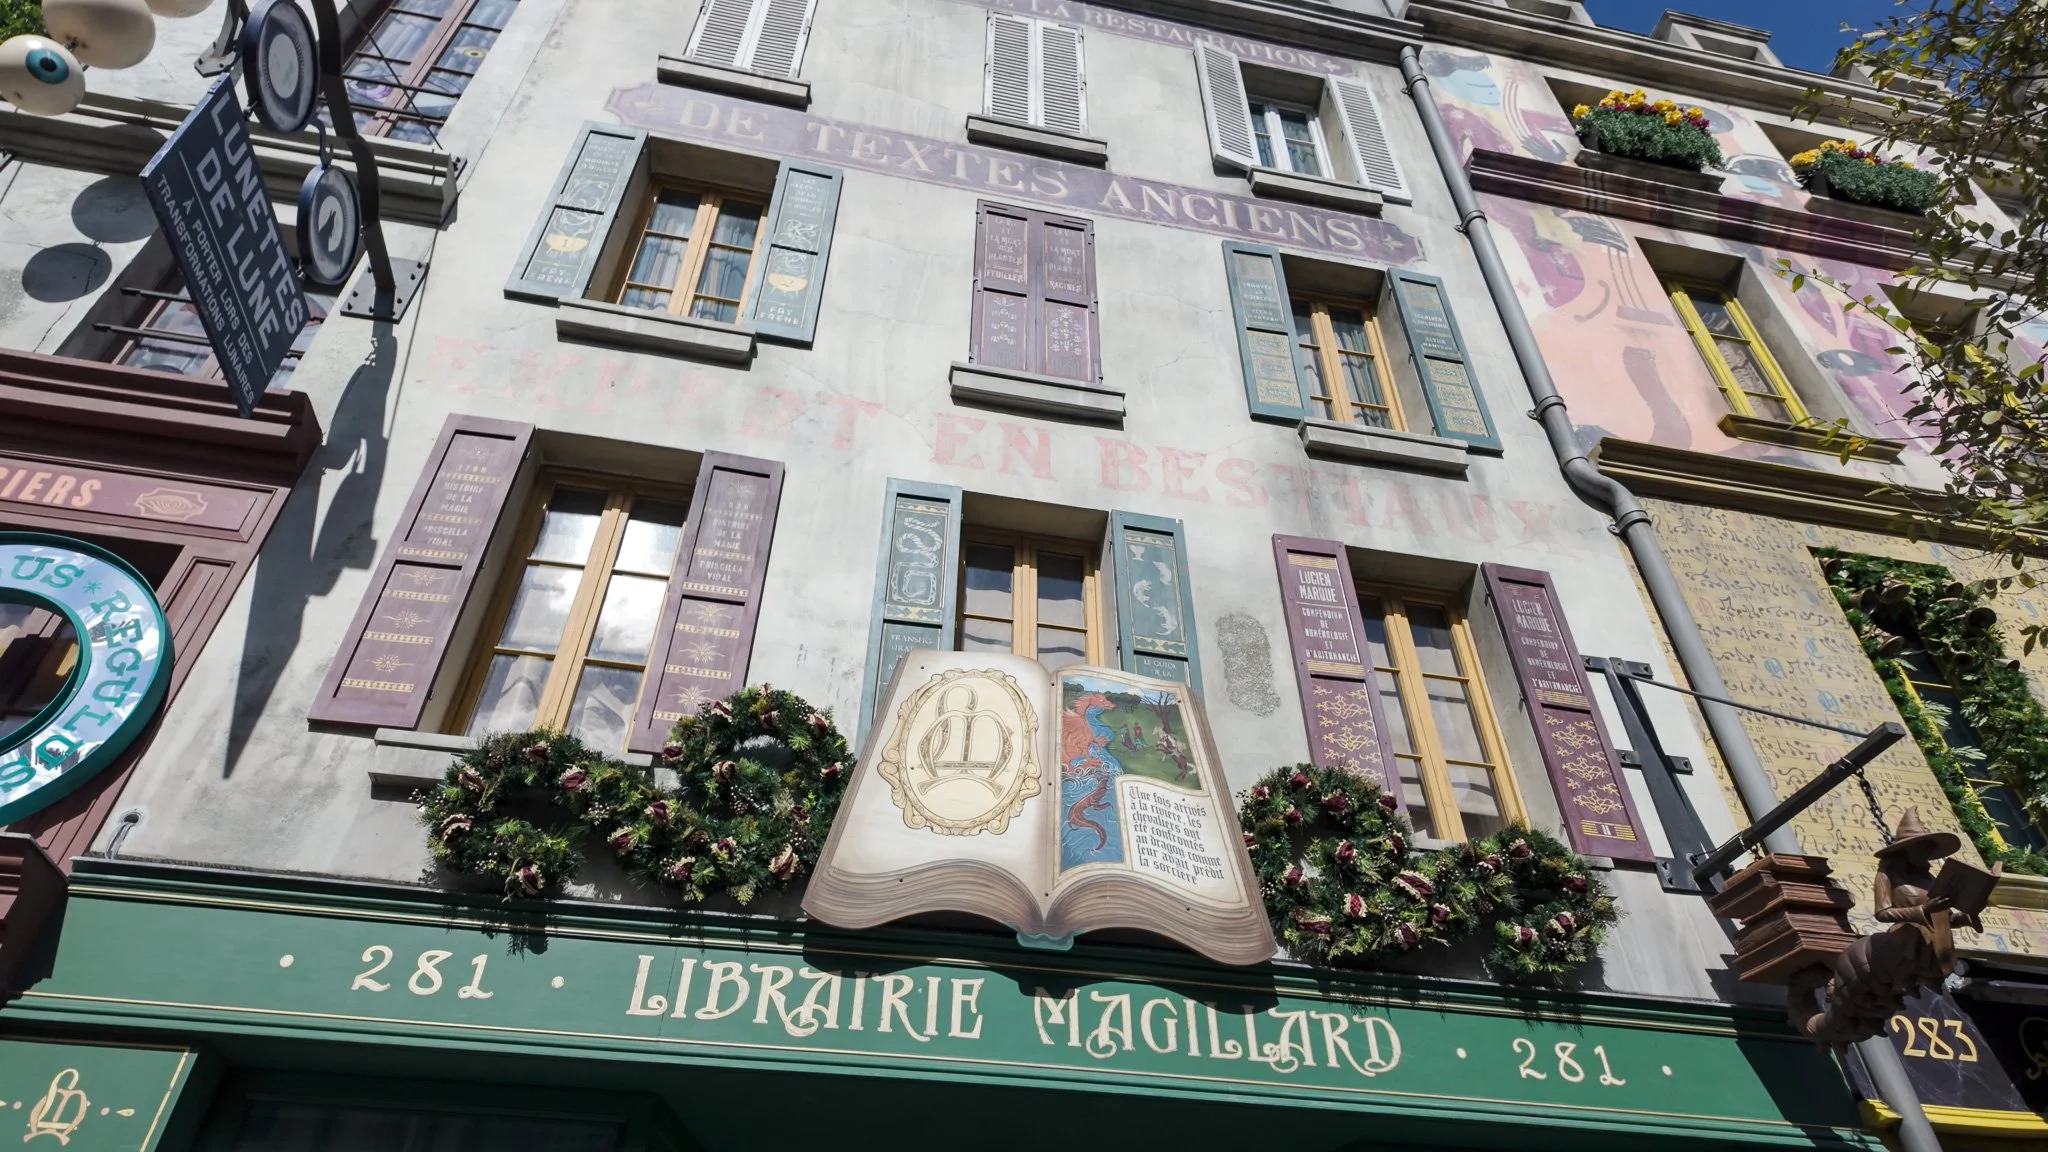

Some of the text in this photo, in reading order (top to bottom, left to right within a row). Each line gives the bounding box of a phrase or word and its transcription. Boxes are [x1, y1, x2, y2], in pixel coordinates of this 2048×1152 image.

[1083, 9, 1321, 69] RESTAURATION
[679, 101, 1367, 254] DE TEXTES ANCIENS
[210, 90, 304, 336] LUNETTES
[196, 148, 281, 352] DE LUNE
[157, 173, 256, 405] TRANSFORMATIONS LUNAIRES
[192, 216, 223, 286] PORTER
[220, 287, 241, 332] LORS
[237, 331, 254, 366] DES
[928, 411, 1058, 482] EN
[0, 466, 103, 507] IERS
[0, 555, 86, 589] US
[1299, 569, 1332, 586] LUCIEN
[1299, 585, 1338, 603] MARQUE
[1511, 598, 1544, 616] LUCIEN
[1319, 620, 1329, 629] DE
[1516, 614, 1553, 633] MARQUE
[1324, 641, 1334, 650] ET
[1539, 649, 1549, 659] DE
[1547, 670, 1556, 680] ET
[1129, 785, 1207, 817] Une fois arrivés
[1139, 800, 1148, 811] la
[1187, 815, 1202, 829] les
[1132, 811, 1201, 841] chevaliers ont
[1134, 821, 1205, 853] été confrontés
[1135, 835, 1222, 867] au dragon comme
[1137, 843, 1225, 880] leur avait prédit
[1139, 855, 1198, 885] la sorcière
[350, 944, 495, 1000] 281
[625, 953, 1402, 1077] LIBRAIRIE MAGILLARD
[1890, 1014, 1979, 1063] 283
[1511, 1037, 1627, 1088] 281
